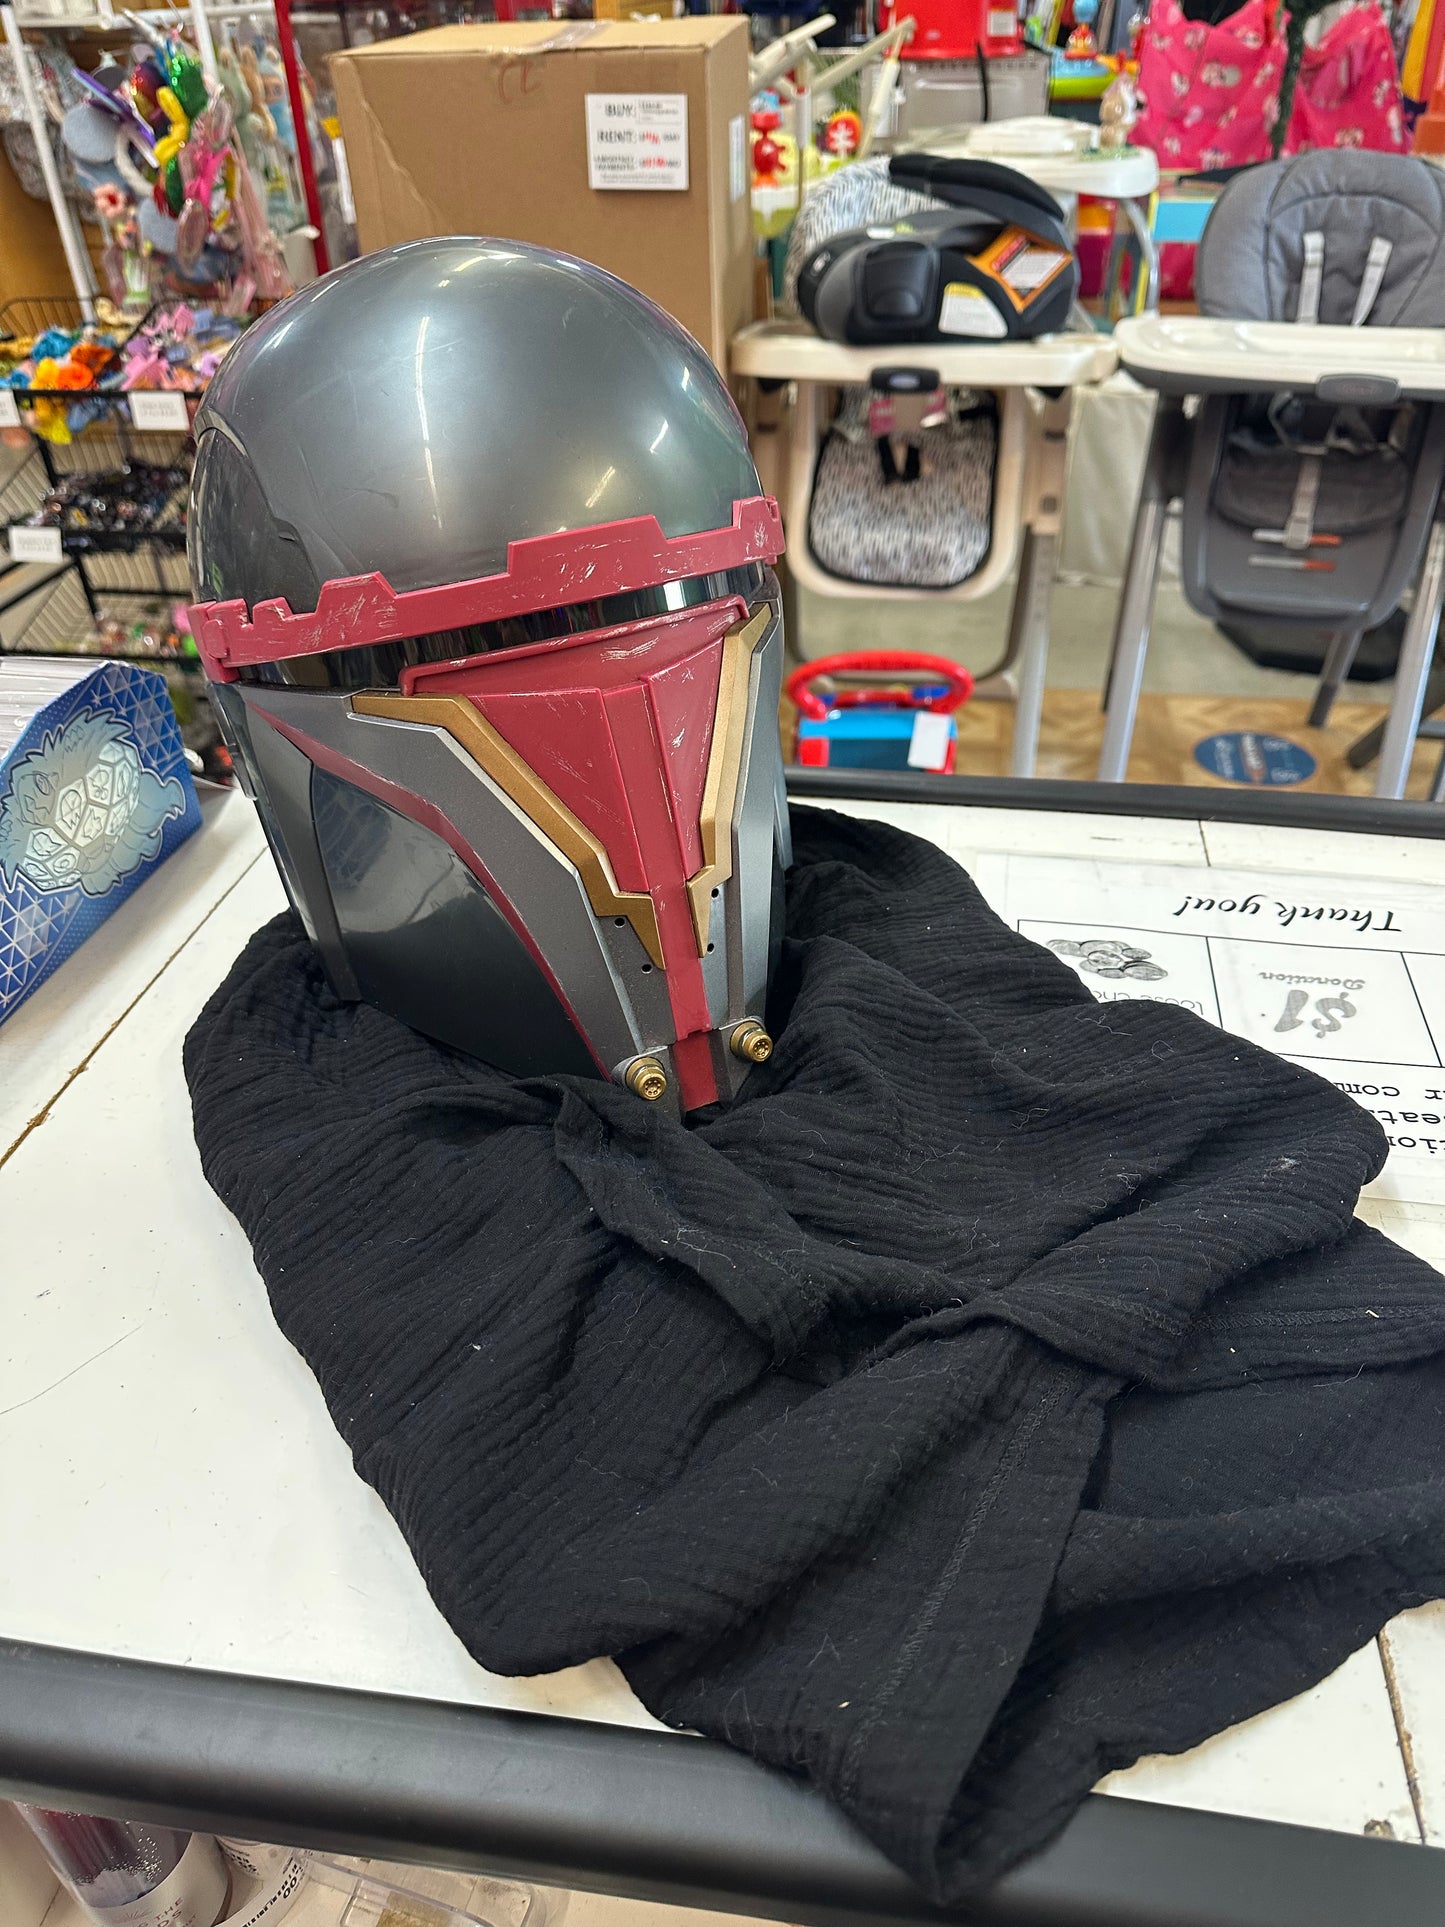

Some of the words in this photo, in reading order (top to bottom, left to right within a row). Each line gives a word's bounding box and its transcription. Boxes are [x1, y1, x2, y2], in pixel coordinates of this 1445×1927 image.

[1173, 894, 1268, 917] you!
[1275, 901, 1403, 932] Thank
[1258, 971, 1366, 991] Donation
[1273, 990, 1358, 1039] $1
